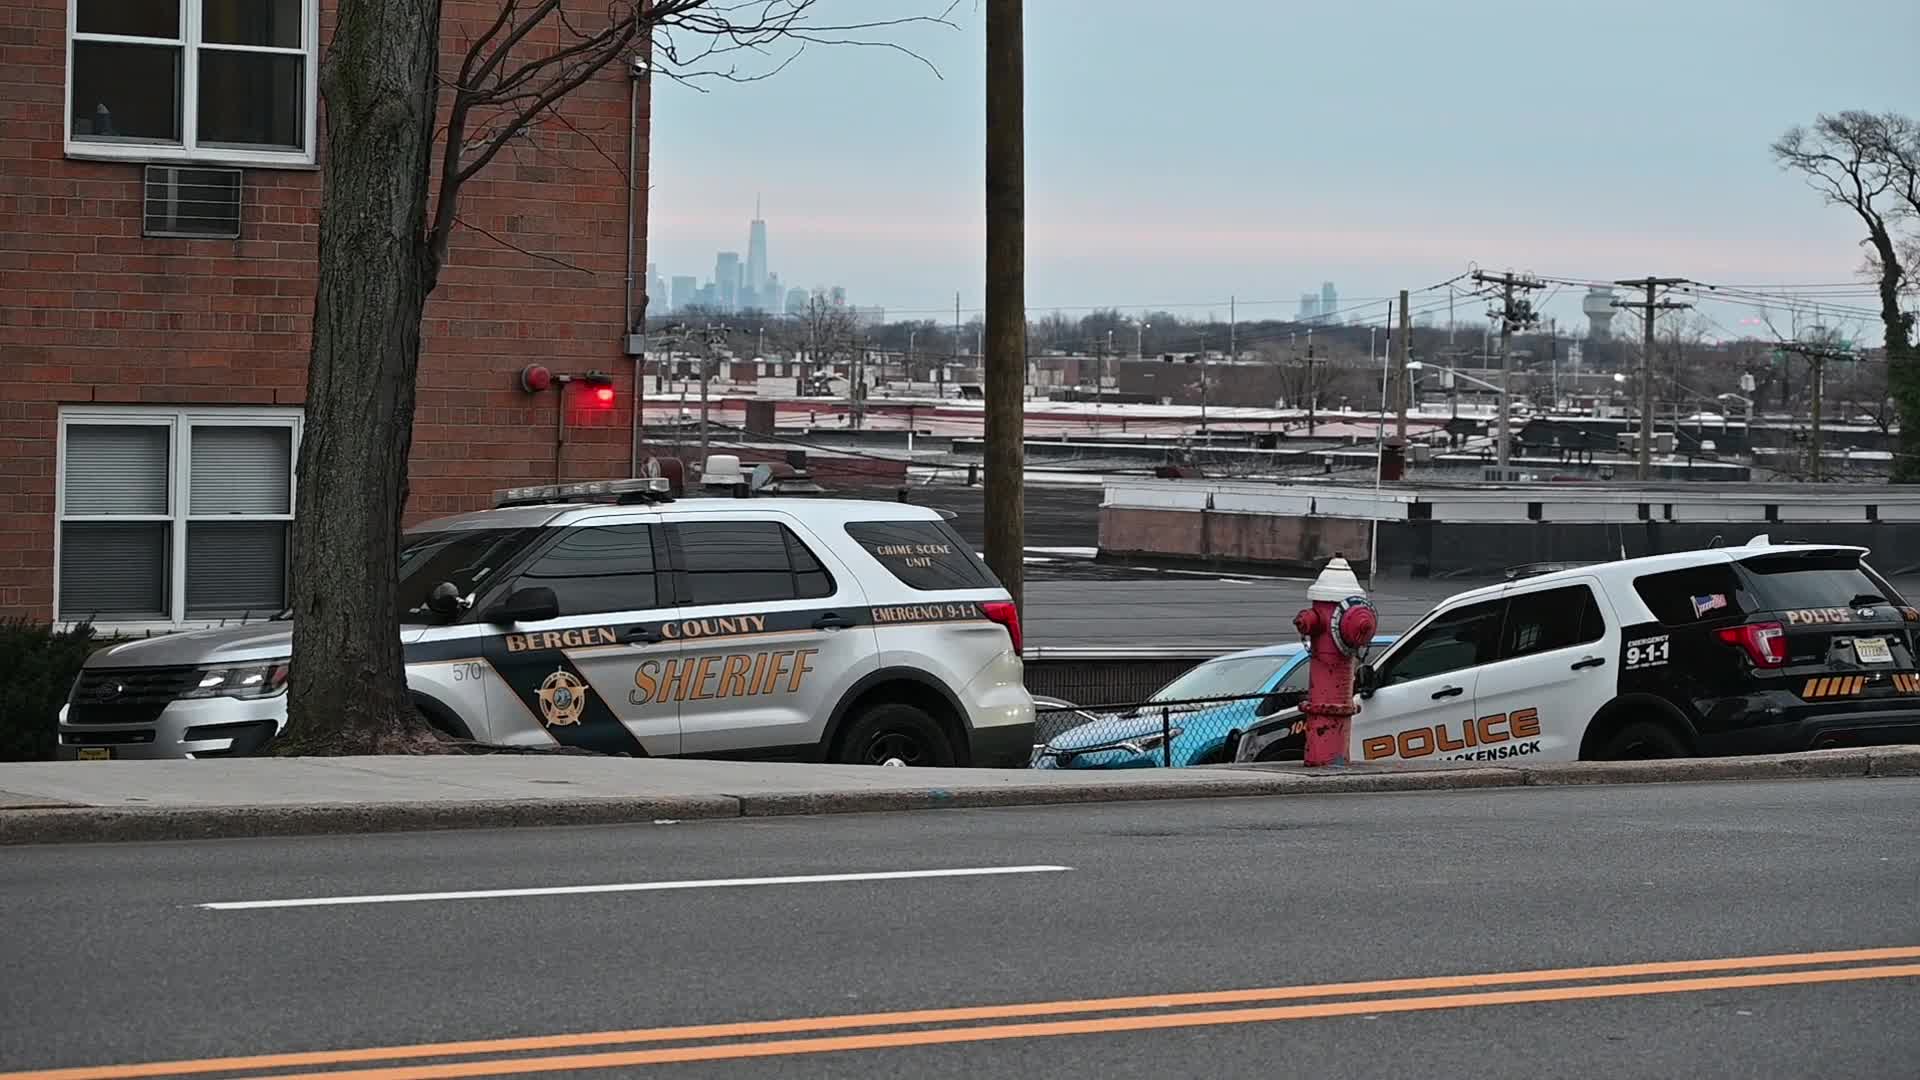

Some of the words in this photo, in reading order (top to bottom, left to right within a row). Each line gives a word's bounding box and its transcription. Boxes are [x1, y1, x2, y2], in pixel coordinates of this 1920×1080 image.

[876, 545, 914, 556] CRIME
[915, 544, 951, 555] SCENE
[905, 557, 933, 568] UNIT
[871, 604, 944, 623] EMERGENCY
[946, 603, 977, 618] 9-1-1
[1786, 608, 1850, 625] POLICE
[505, 627, 617, 652] BERGEN
[661, 615, 767, 639] COUNTY
[1626, 641, 1669, 664] 9-1-1
[453, 663, 481, 681] 570
[628, 649, 819, 705] SHERIFF
[1362, 707, 1541, 760] POLICE
[1438, 740, 1541, 761] CKENSACK
